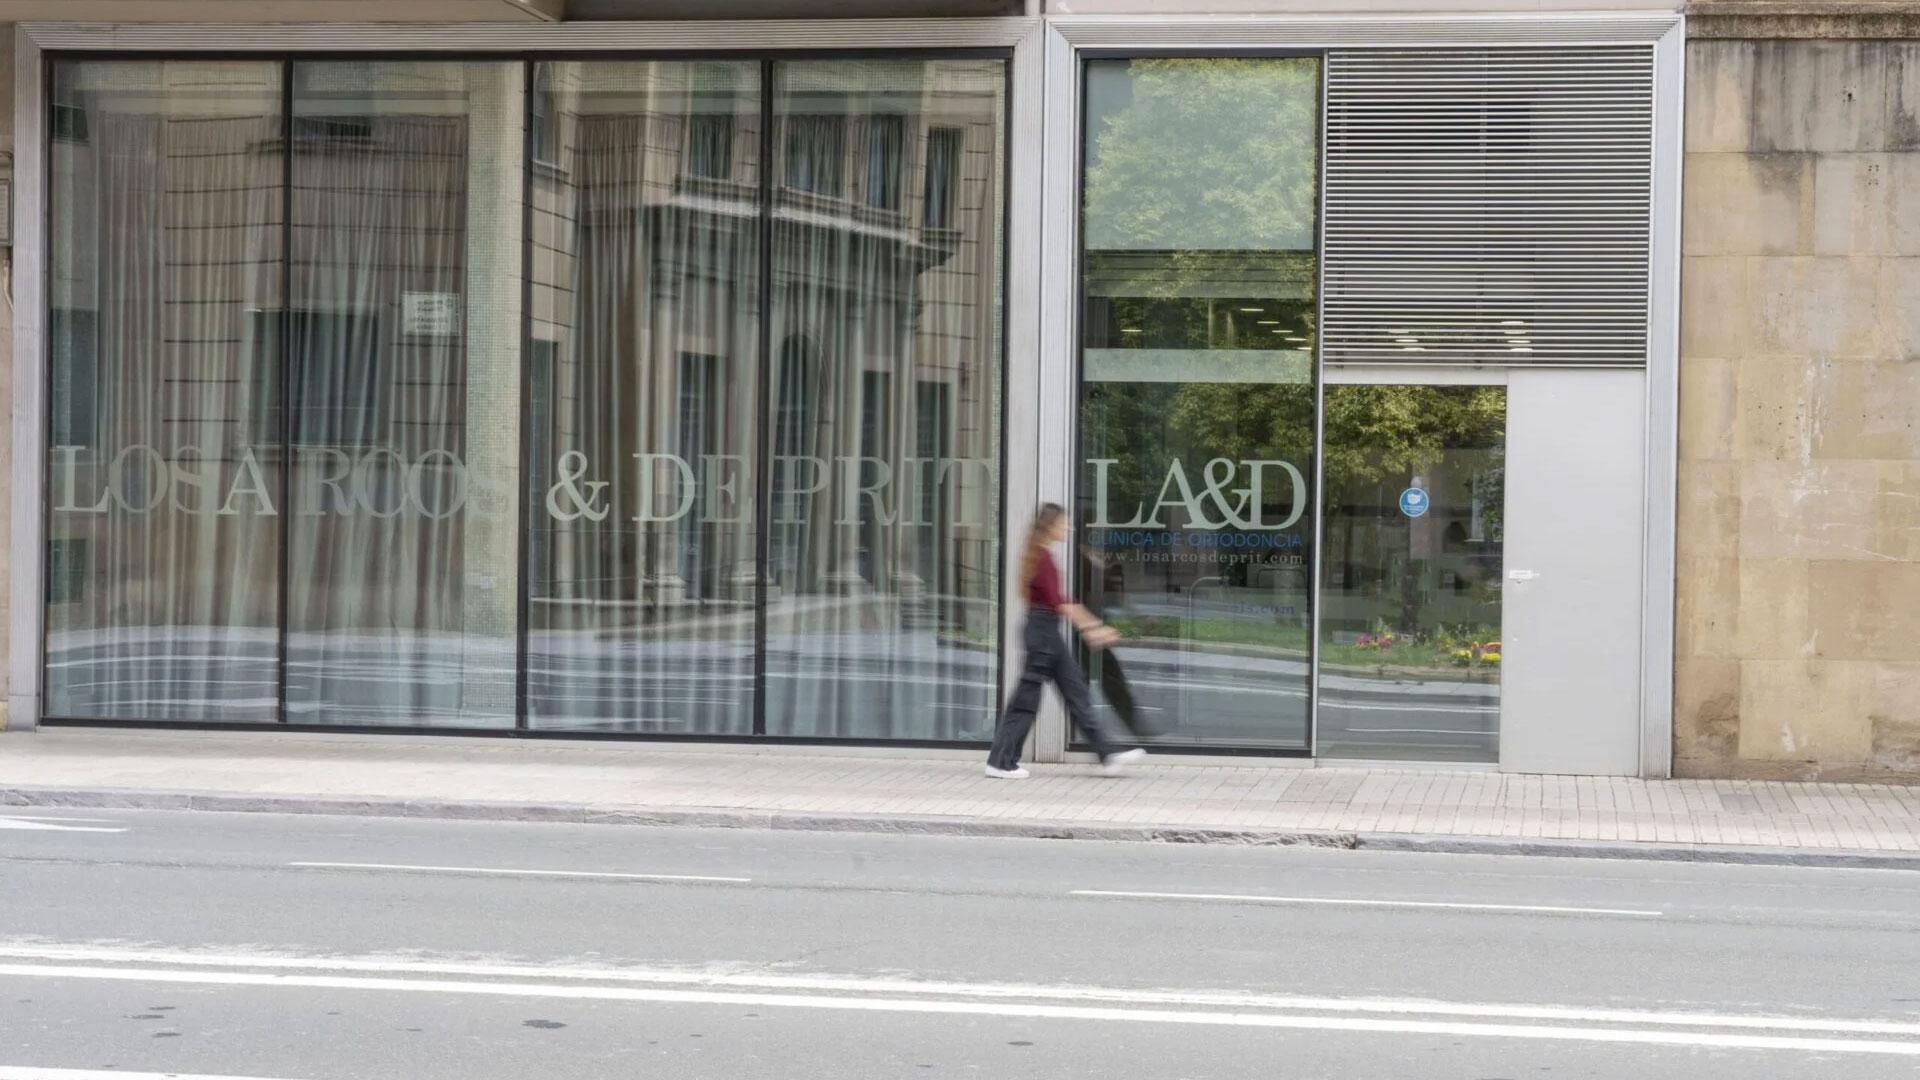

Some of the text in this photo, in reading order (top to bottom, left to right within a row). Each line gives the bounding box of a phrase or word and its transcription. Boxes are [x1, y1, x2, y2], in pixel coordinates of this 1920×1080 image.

[546, 450, 610, 522] &
[632, 452, 753, 523] DE
[773, 454, 994, 527] PRIT
[1086, 457, 1307, 530] LA&D
[1160, 531, 1183, 546] DE
[1188, 532, 1302, 548] ORTODONCIA
